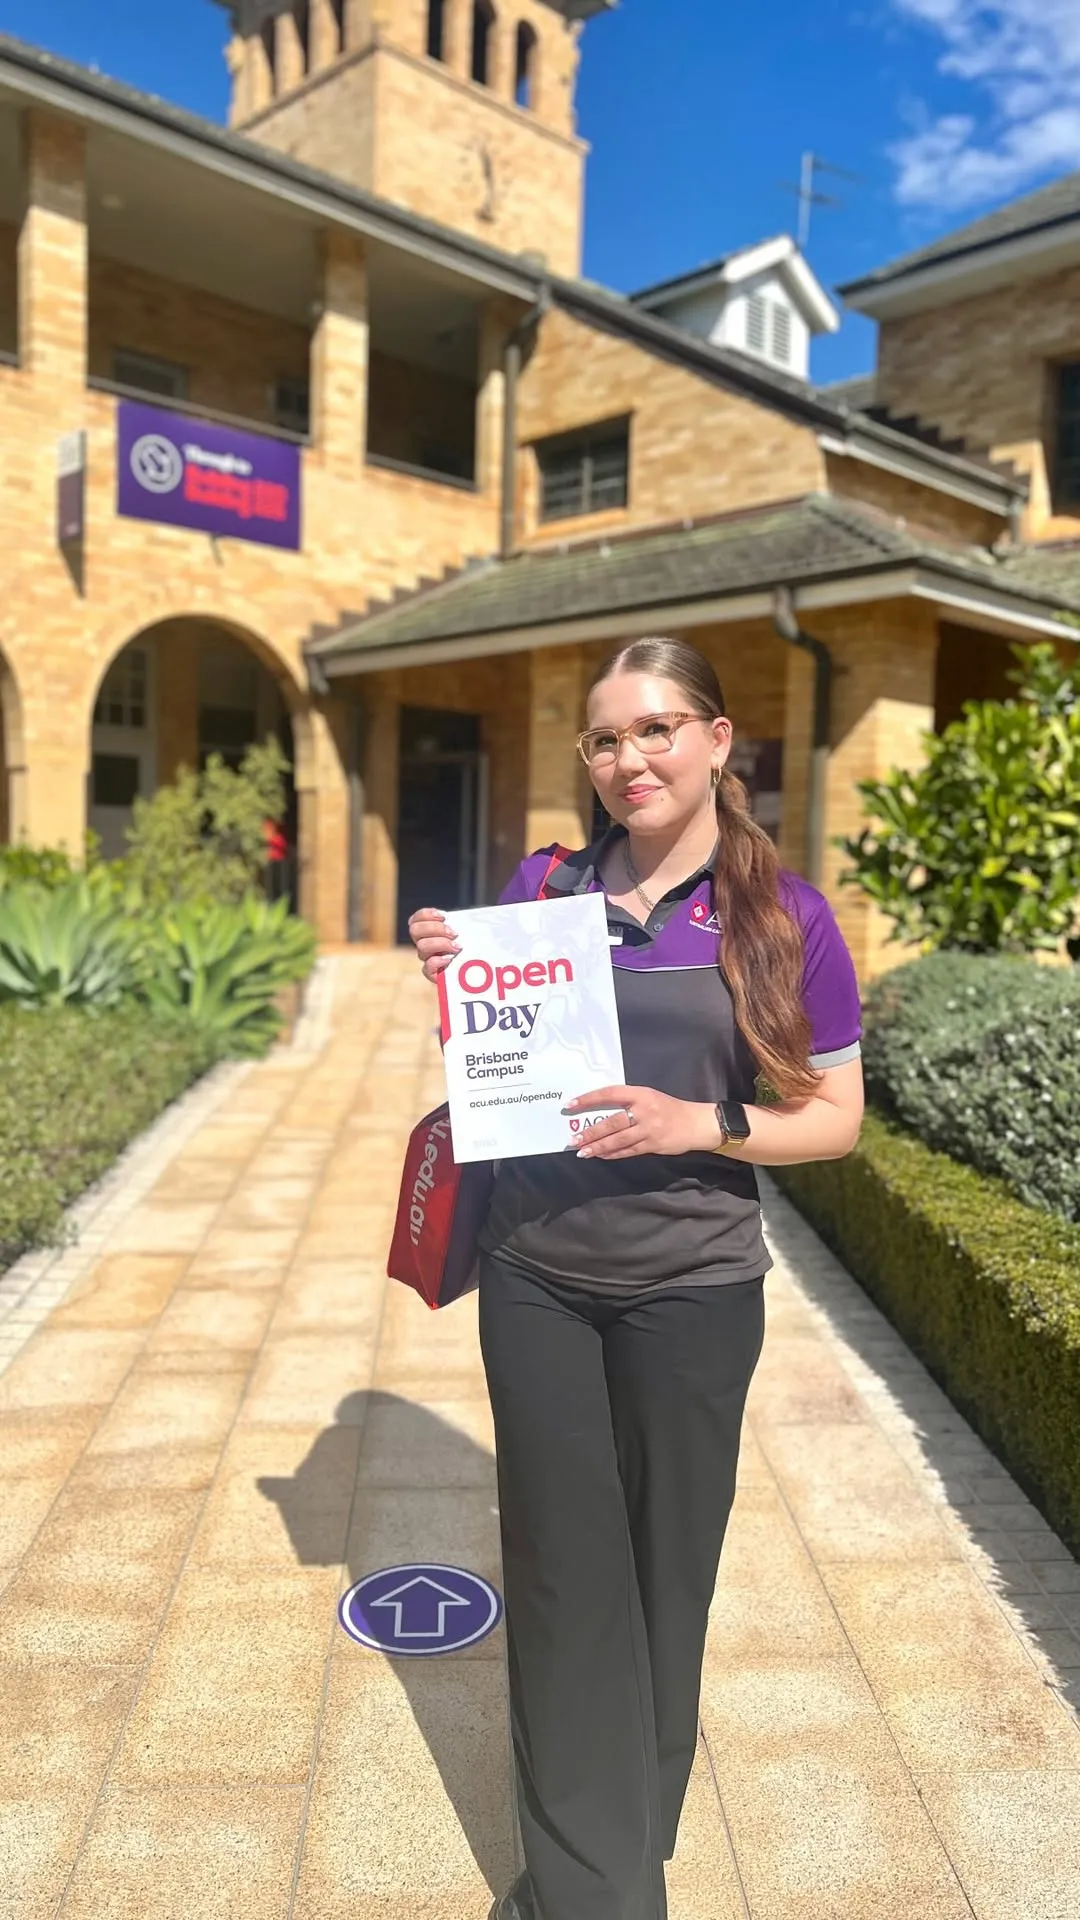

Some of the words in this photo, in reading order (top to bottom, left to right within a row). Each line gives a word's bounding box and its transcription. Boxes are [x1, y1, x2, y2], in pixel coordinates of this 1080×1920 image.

[458, 957, 573, 1001] Open
[460, 1000, 543, 1038] Day
[465, 1050, 529, 1067] Brisbane
[466, 1064, 525, 1080] Campus
[469, 1090, 563, 1109] acu.edu.au/openday
[410, 1118, 451, 1246] u.edu.au
